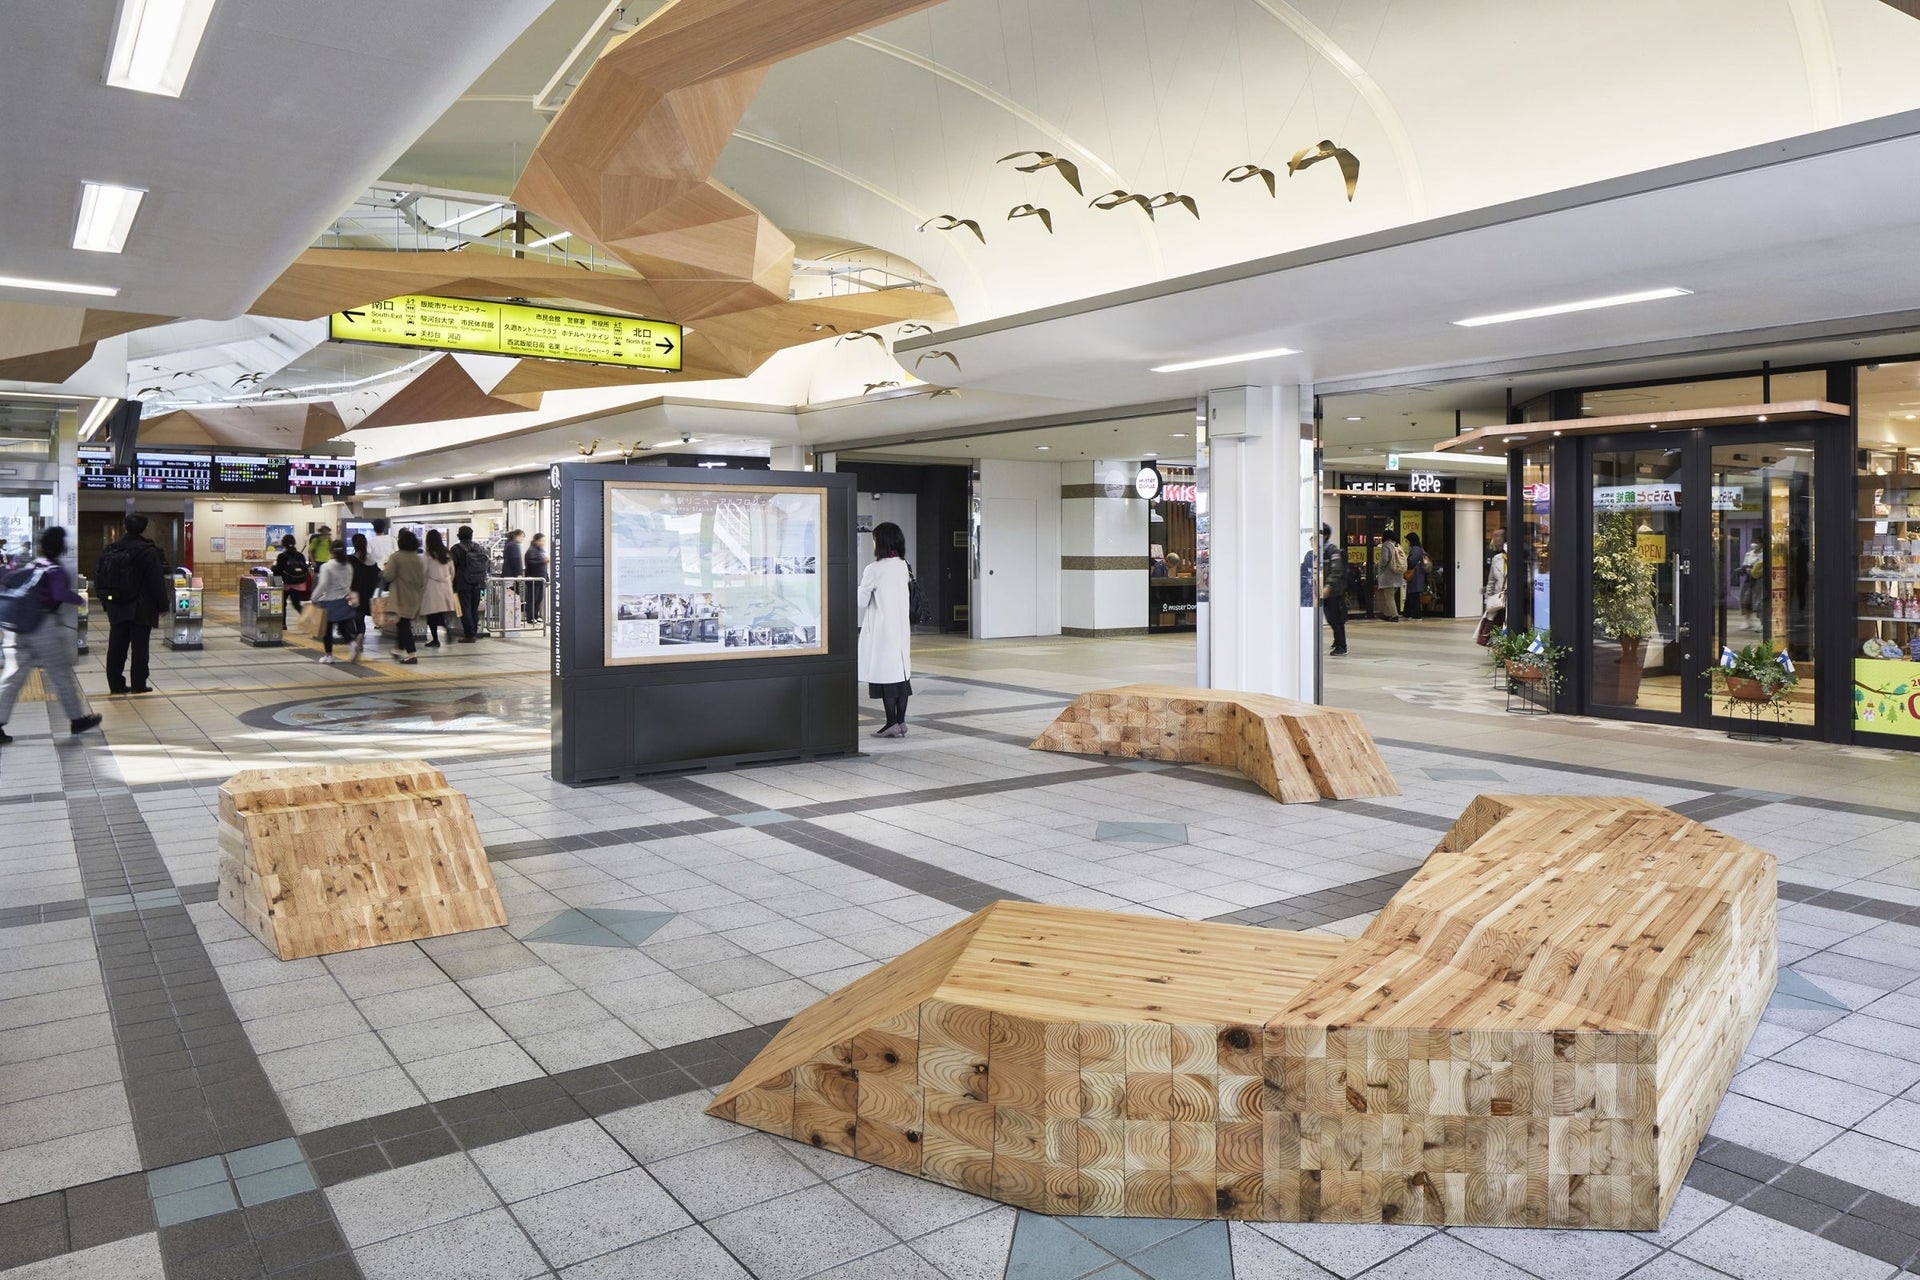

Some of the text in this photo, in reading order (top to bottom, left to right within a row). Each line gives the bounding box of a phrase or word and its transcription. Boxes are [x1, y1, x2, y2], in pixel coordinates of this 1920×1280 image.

[420, 300, 487, 313] 飯能市サービスコーナー
[420, 315, 455, 325] 駿河台大学
[461, 319, 495, 329] 市民体育館
[535, 313, 561, 322] 市民会館
[567, 317, 586, 325] 警察署
[591, 320, 610, 328] 市役所
[420, 330, 441, 338] 美杉台
[633, 327, 652, 338] 北口
[1411, 473, 1441, 493] PePe
[1402, 521, 1419, 530] OPEN
[260, 593, 269, 601] IC
